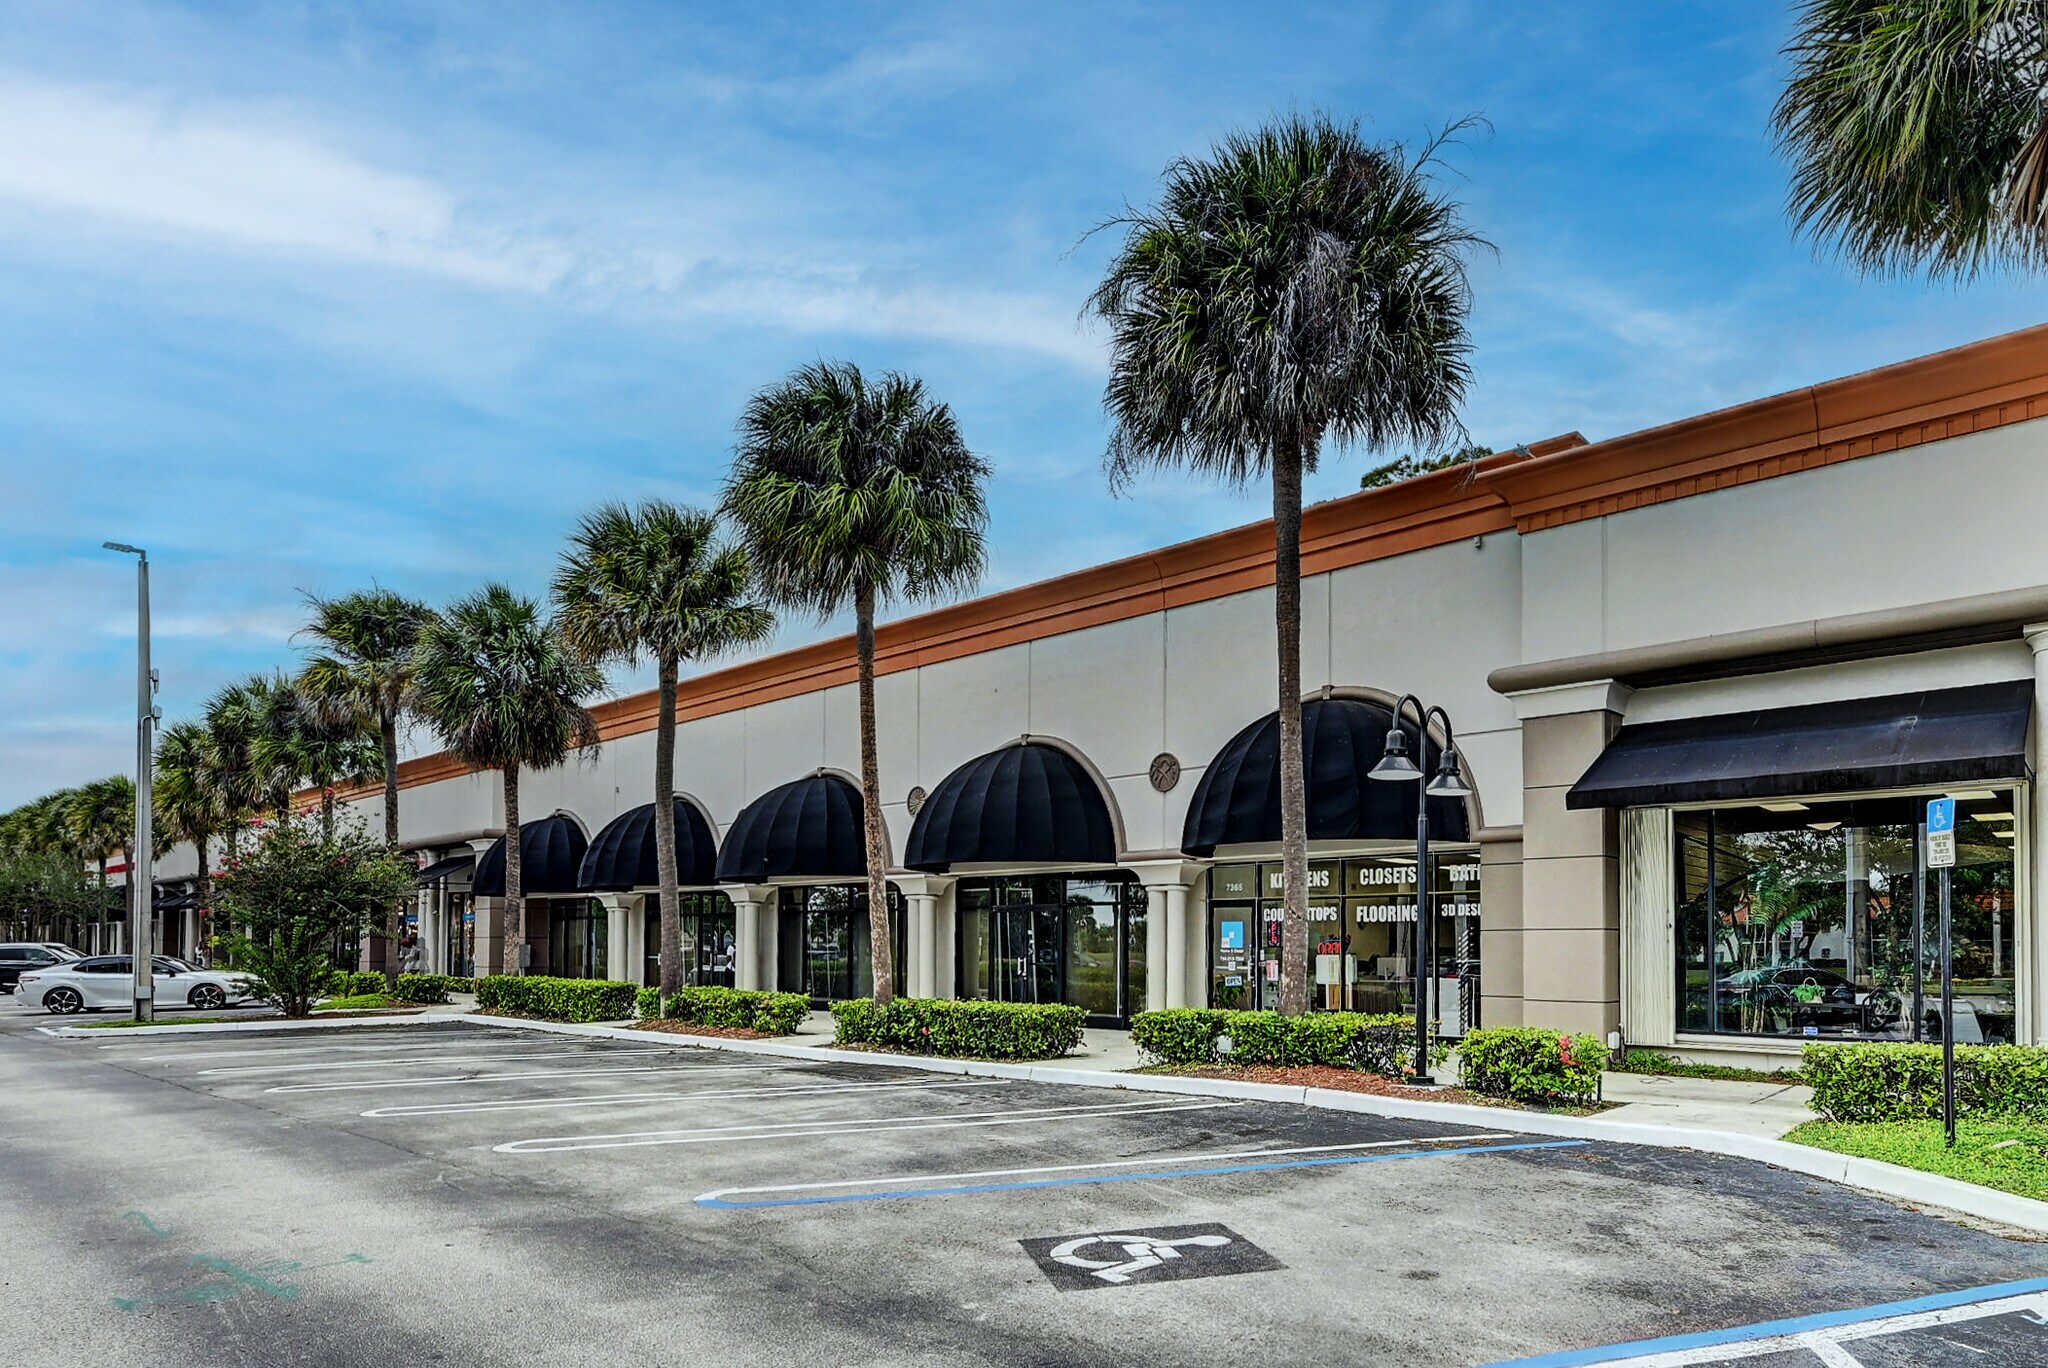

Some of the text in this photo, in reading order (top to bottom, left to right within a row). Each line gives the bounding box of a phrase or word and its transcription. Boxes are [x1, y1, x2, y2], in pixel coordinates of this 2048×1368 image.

[1270, 870, 1329, 889] KIENS
[1359, 866, 1417, 885] CLOSETS
[1226, 883, 1243, 892] 7365
[1263, 906, 1338, 922] COUTOPS
[1356, 904, 1418, 923] FLOORING
[1441, 903, 1456, 917] 3D
